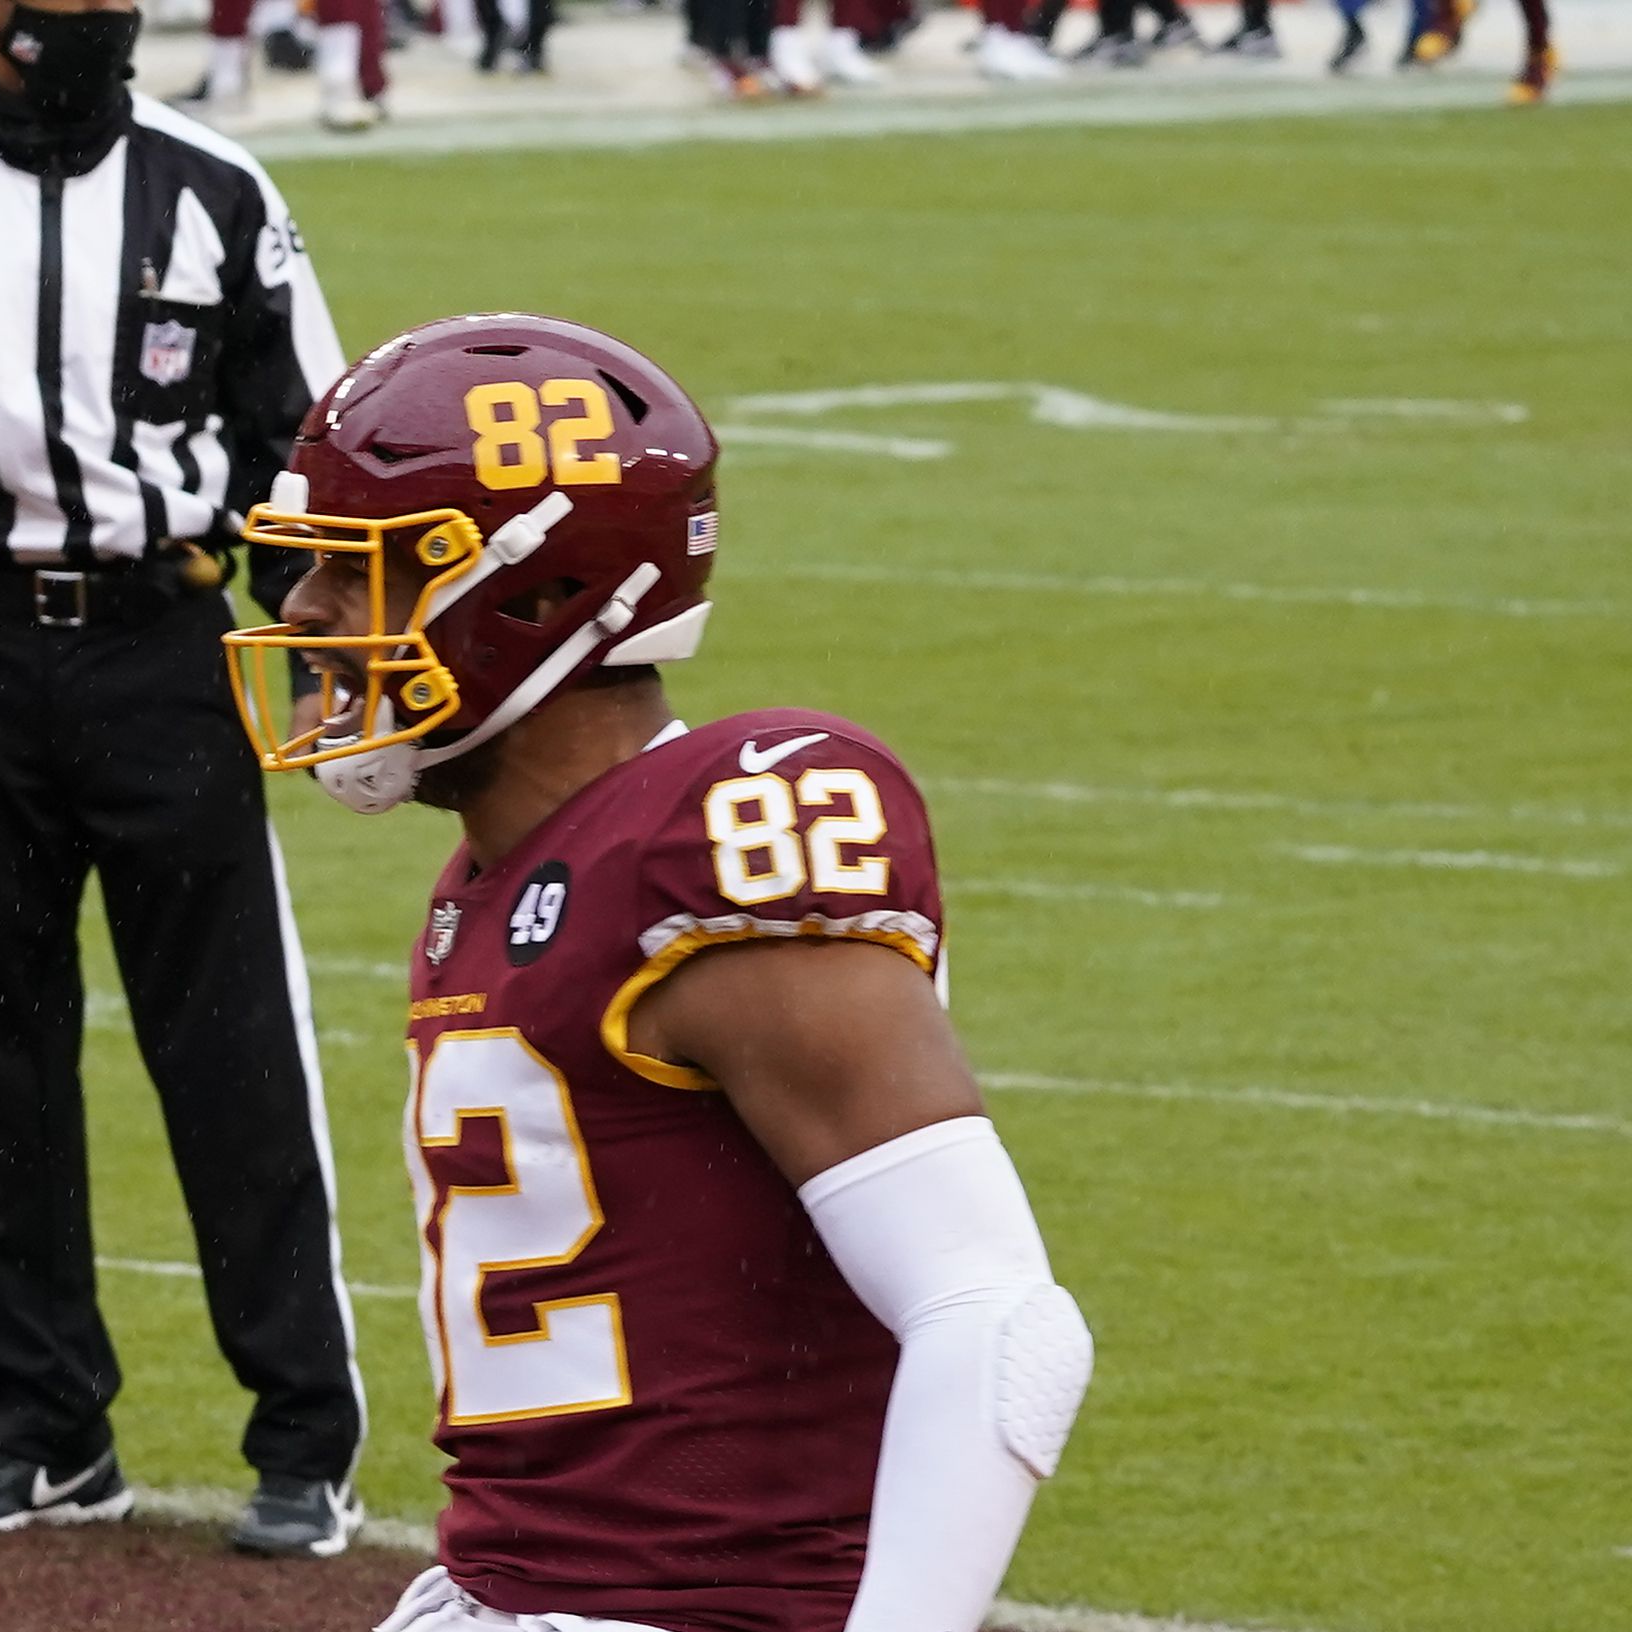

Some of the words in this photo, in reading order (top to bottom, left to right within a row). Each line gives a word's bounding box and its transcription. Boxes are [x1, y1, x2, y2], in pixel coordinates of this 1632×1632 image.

[463, 378, 623, 491] 82
[704, 768, 891, 907] 82
[509, 883, 567, 945] 49
